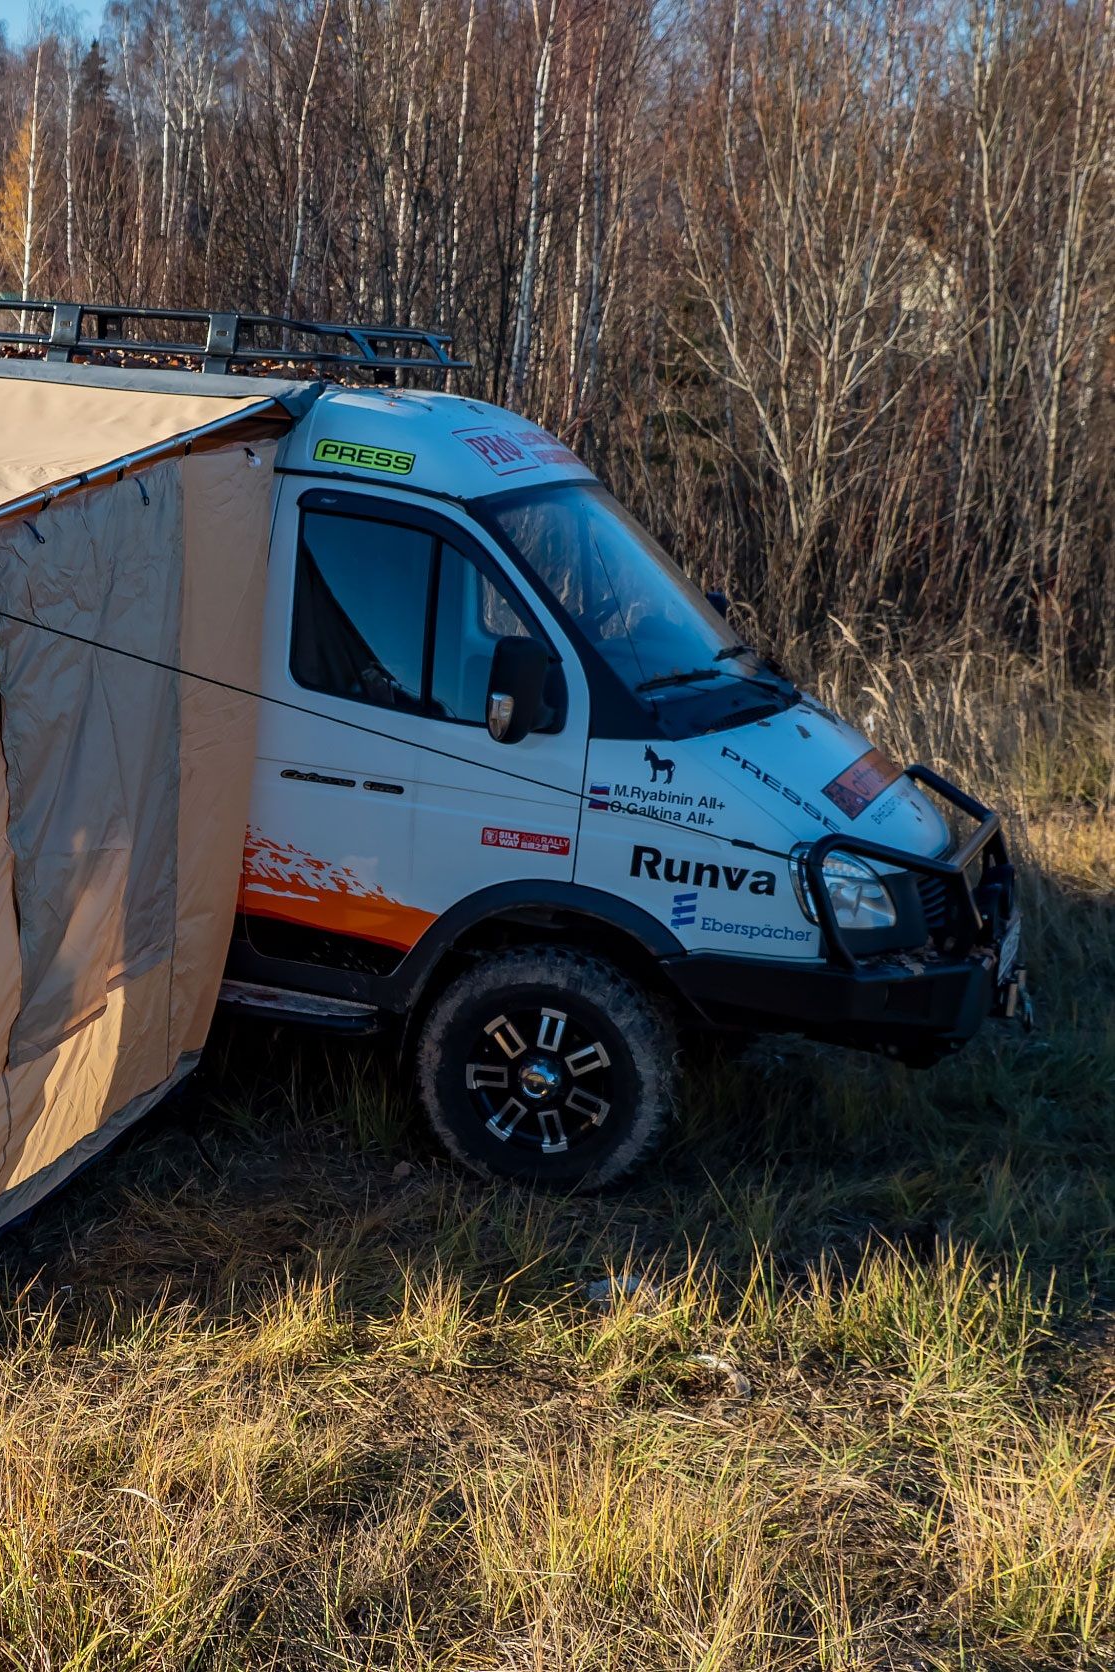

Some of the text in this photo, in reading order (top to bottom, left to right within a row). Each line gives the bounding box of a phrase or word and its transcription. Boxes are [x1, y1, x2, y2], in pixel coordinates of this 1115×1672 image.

[321, 443, 412, 471] PRESS
[463, 434, 526, 466] РИФ
[614, 784, 694, 806] M.Ryabinin
[721, 746, 841, 834] PRESSE
[610, 801, 681, 821] O.Galkina
[499, 831, 520, 840] SILK
[521, 834, 541, 843] 2016
[541, 837, 570, 847] RALLY
[499, 838, 519, 847] WAY
[630, 845, 777, 897] Runva
[700, 917, 813, 942] Eberspächer
